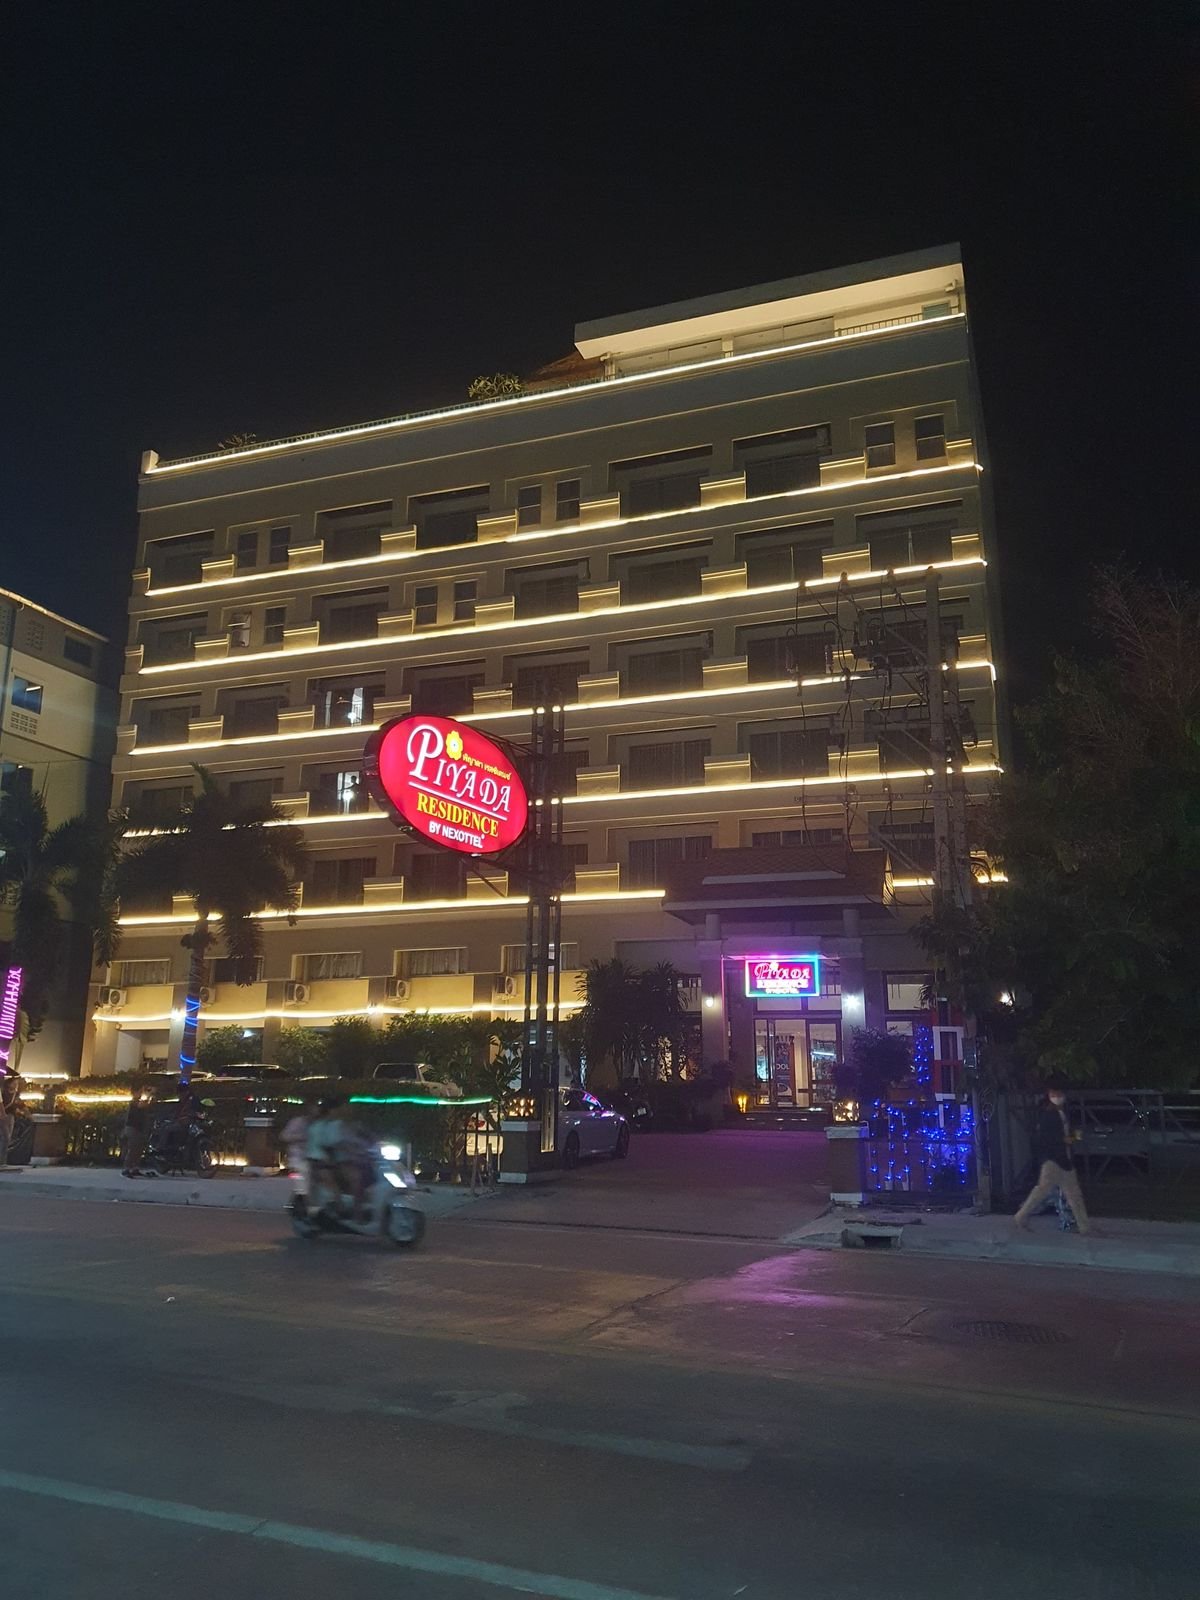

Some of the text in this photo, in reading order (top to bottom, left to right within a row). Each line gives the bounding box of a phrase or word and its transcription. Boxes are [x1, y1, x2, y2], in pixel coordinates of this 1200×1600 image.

[407, 724, 512, 812] PIYADA
[417, 792, 499, 837] RESIDENCE
[429, 821, 441, 834] BY
[754, 962, 810, 980] PIYADA
